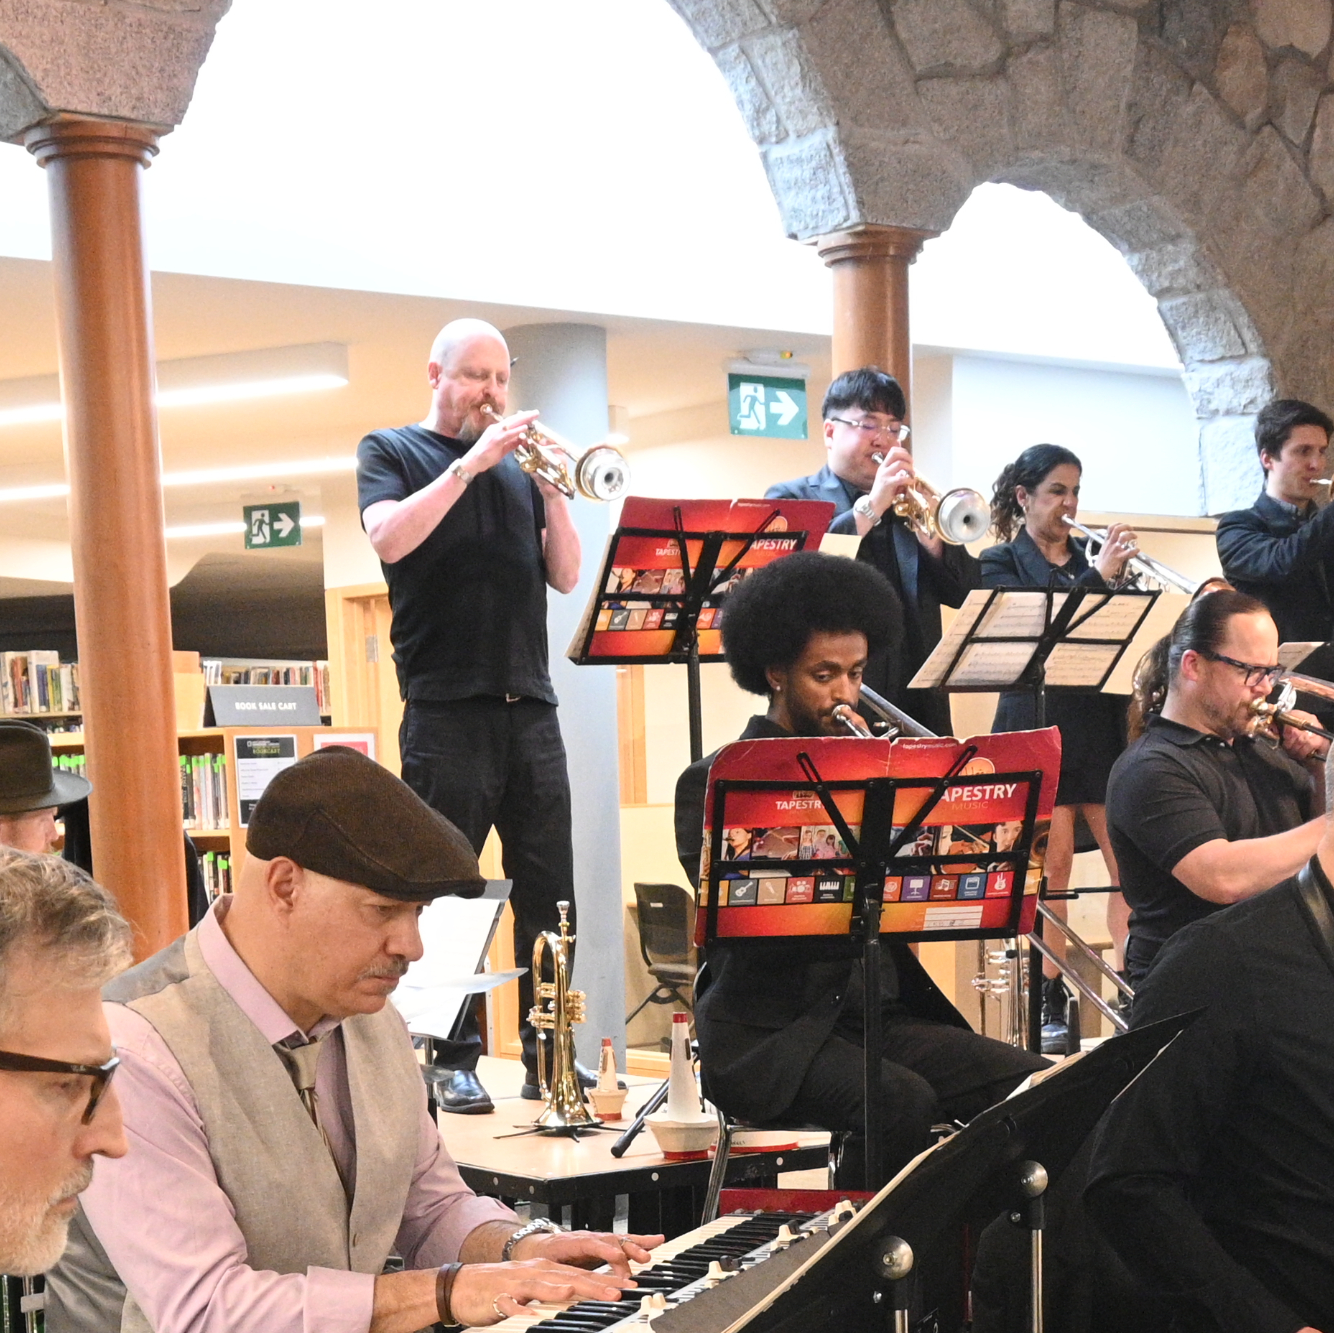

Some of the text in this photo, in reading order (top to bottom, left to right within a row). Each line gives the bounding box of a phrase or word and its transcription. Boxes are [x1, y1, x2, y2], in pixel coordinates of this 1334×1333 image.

[750, 539, 798, 551] APESTRY
[234, 702, 297, 710] BOOK SALE CART
[929, 783, 1017, 802] APESTRY
[775, 800, 825, 810] TAPESTR
[951, 801, 989, 811] MUSIC
